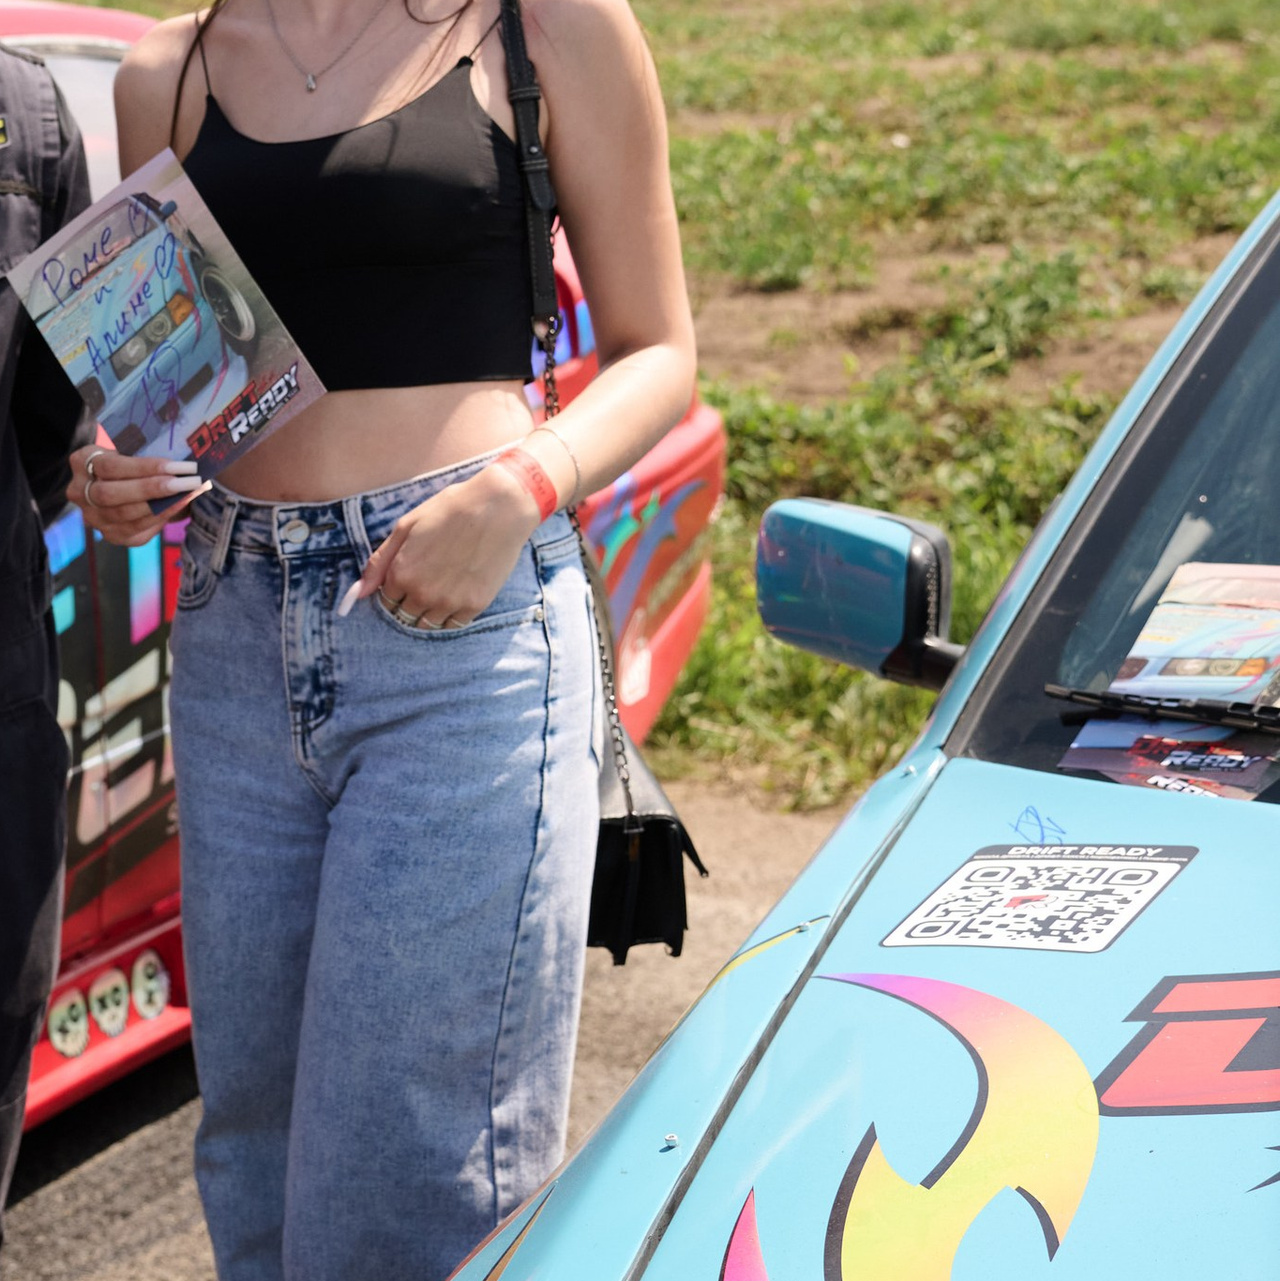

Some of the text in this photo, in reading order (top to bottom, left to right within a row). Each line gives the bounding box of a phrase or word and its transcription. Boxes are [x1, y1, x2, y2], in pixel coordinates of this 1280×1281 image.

[41, 226, 112, 308] Роме
[186, 380, 259, 459] DRIFT
[228, 363, 299, 444] READY
[1160, 750, 1262, 769] READY
[1007, 846, 1163, 857] DRIFT READY
